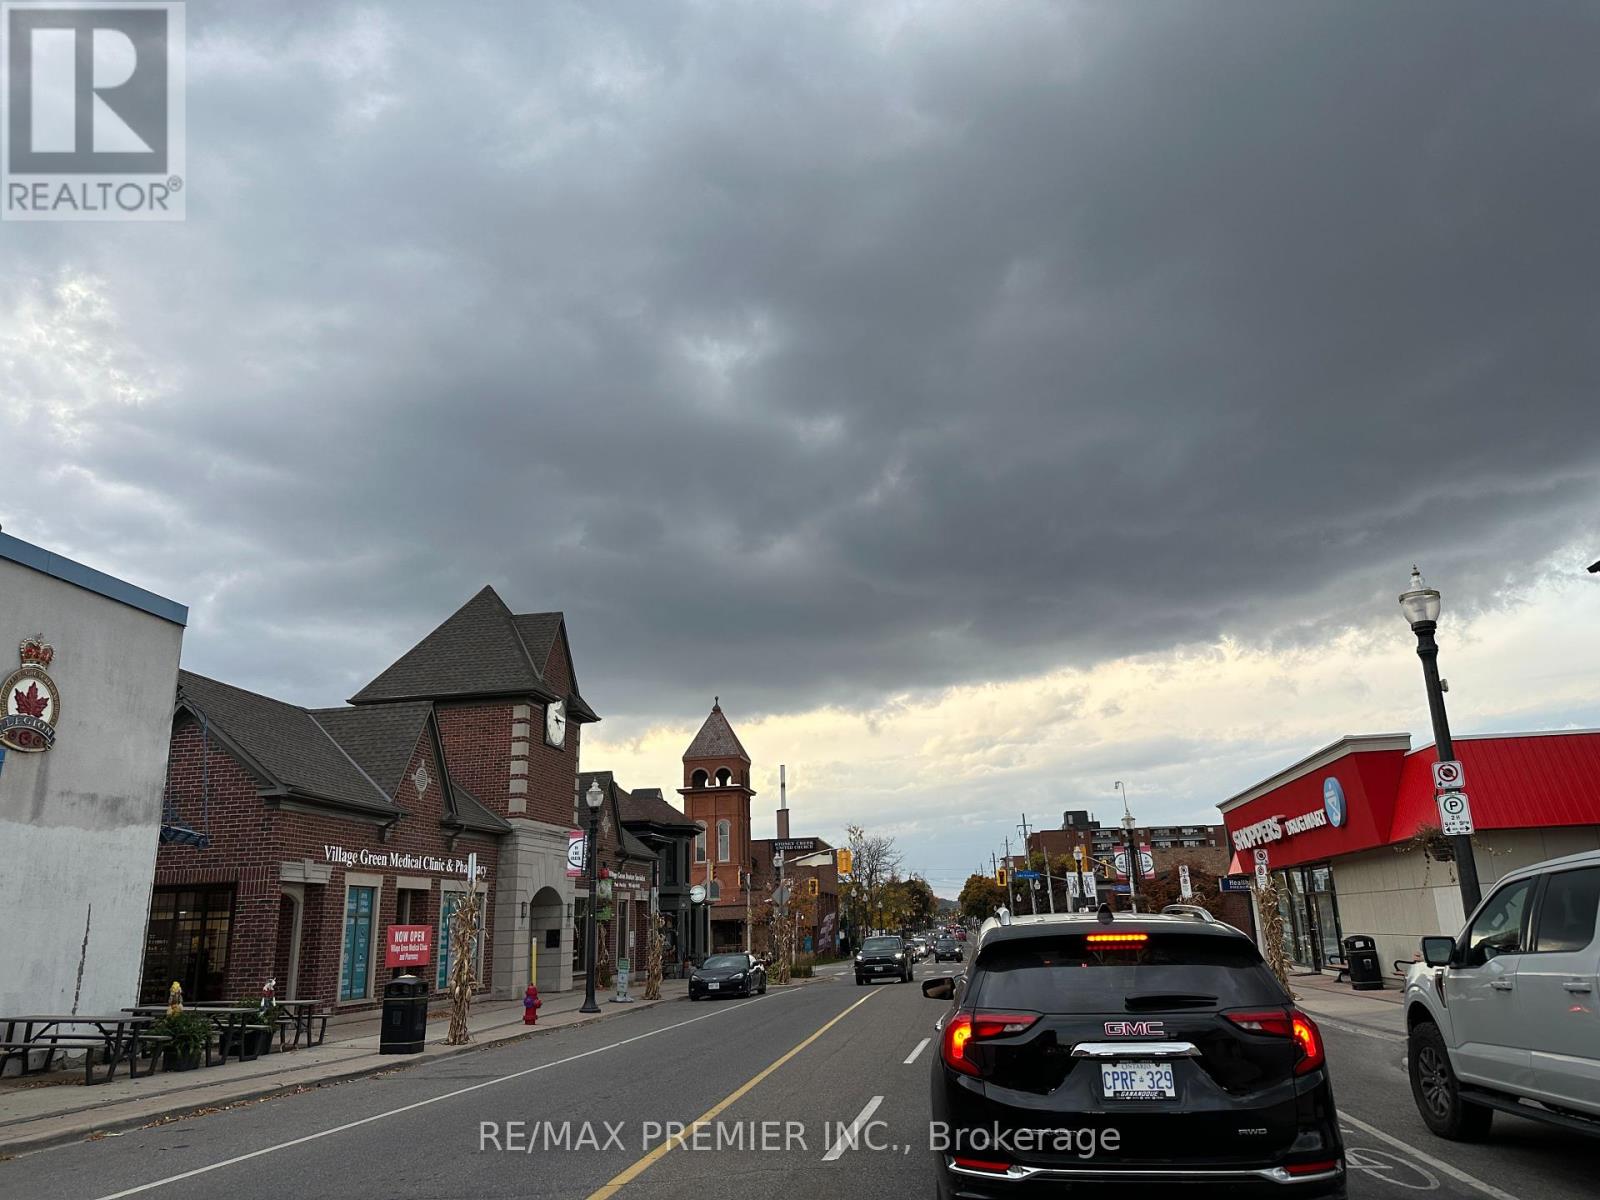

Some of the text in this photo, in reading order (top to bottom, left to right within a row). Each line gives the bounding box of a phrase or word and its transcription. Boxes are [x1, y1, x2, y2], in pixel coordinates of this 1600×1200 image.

[6, 717, 53, 735] LEGION
[1232, 817, 1282, 852] SHOPPERS
[324, 845, 488, 878] Village Green Medical Clinic & Phaacy
[395, 930, 425, 942] NOW OPEN
[1104, 1021, 1165, 1036] GMC
[1103, 1071, 1173, 1090] CPRF 329
